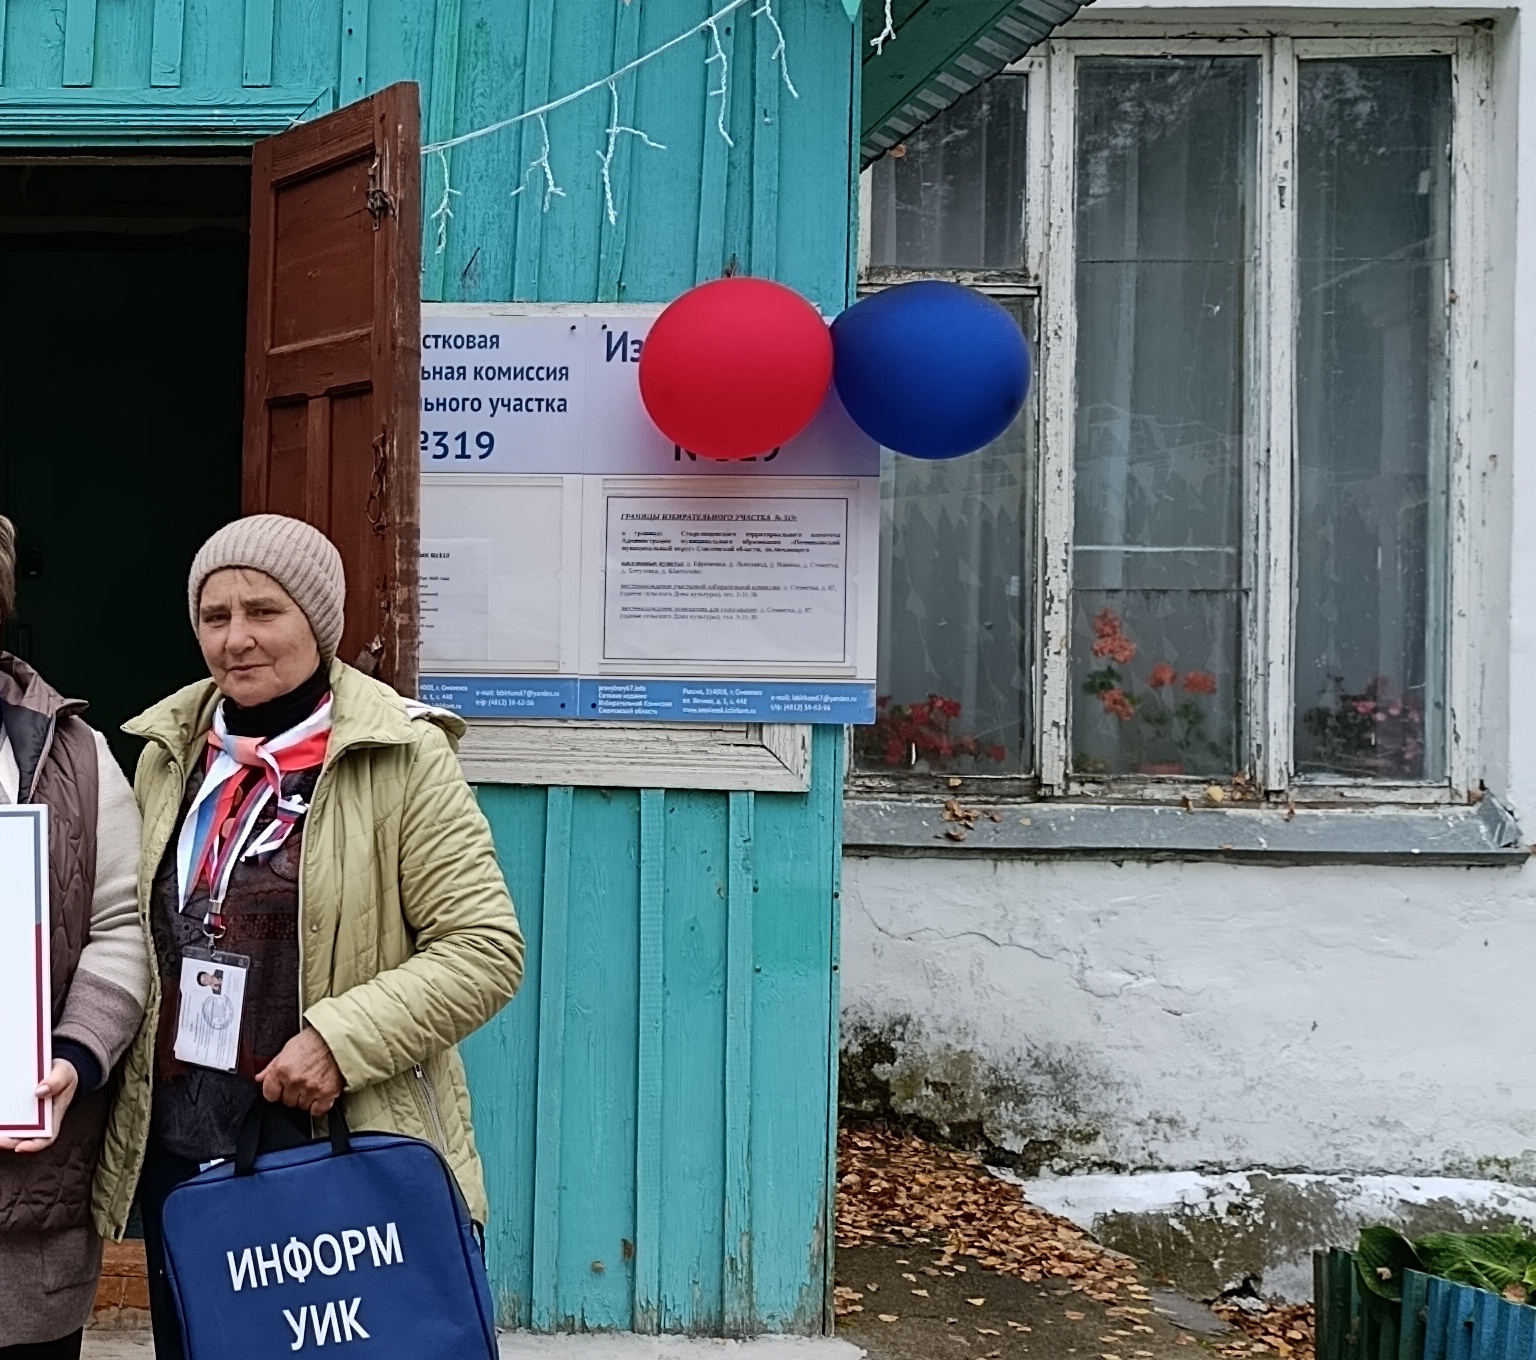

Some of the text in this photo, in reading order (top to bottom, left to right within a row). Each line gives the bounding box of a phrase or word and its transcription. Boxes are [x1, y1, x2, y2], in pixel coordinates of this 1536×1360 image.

[421, 334, 500, 350] стковая
[473, 366, 569, 382] комиссия
[488, 397, 568, 418] участка
[226, 1222, 404, 1292] ИНФОРМ
[282, 1296, 371, 1352] УИК
